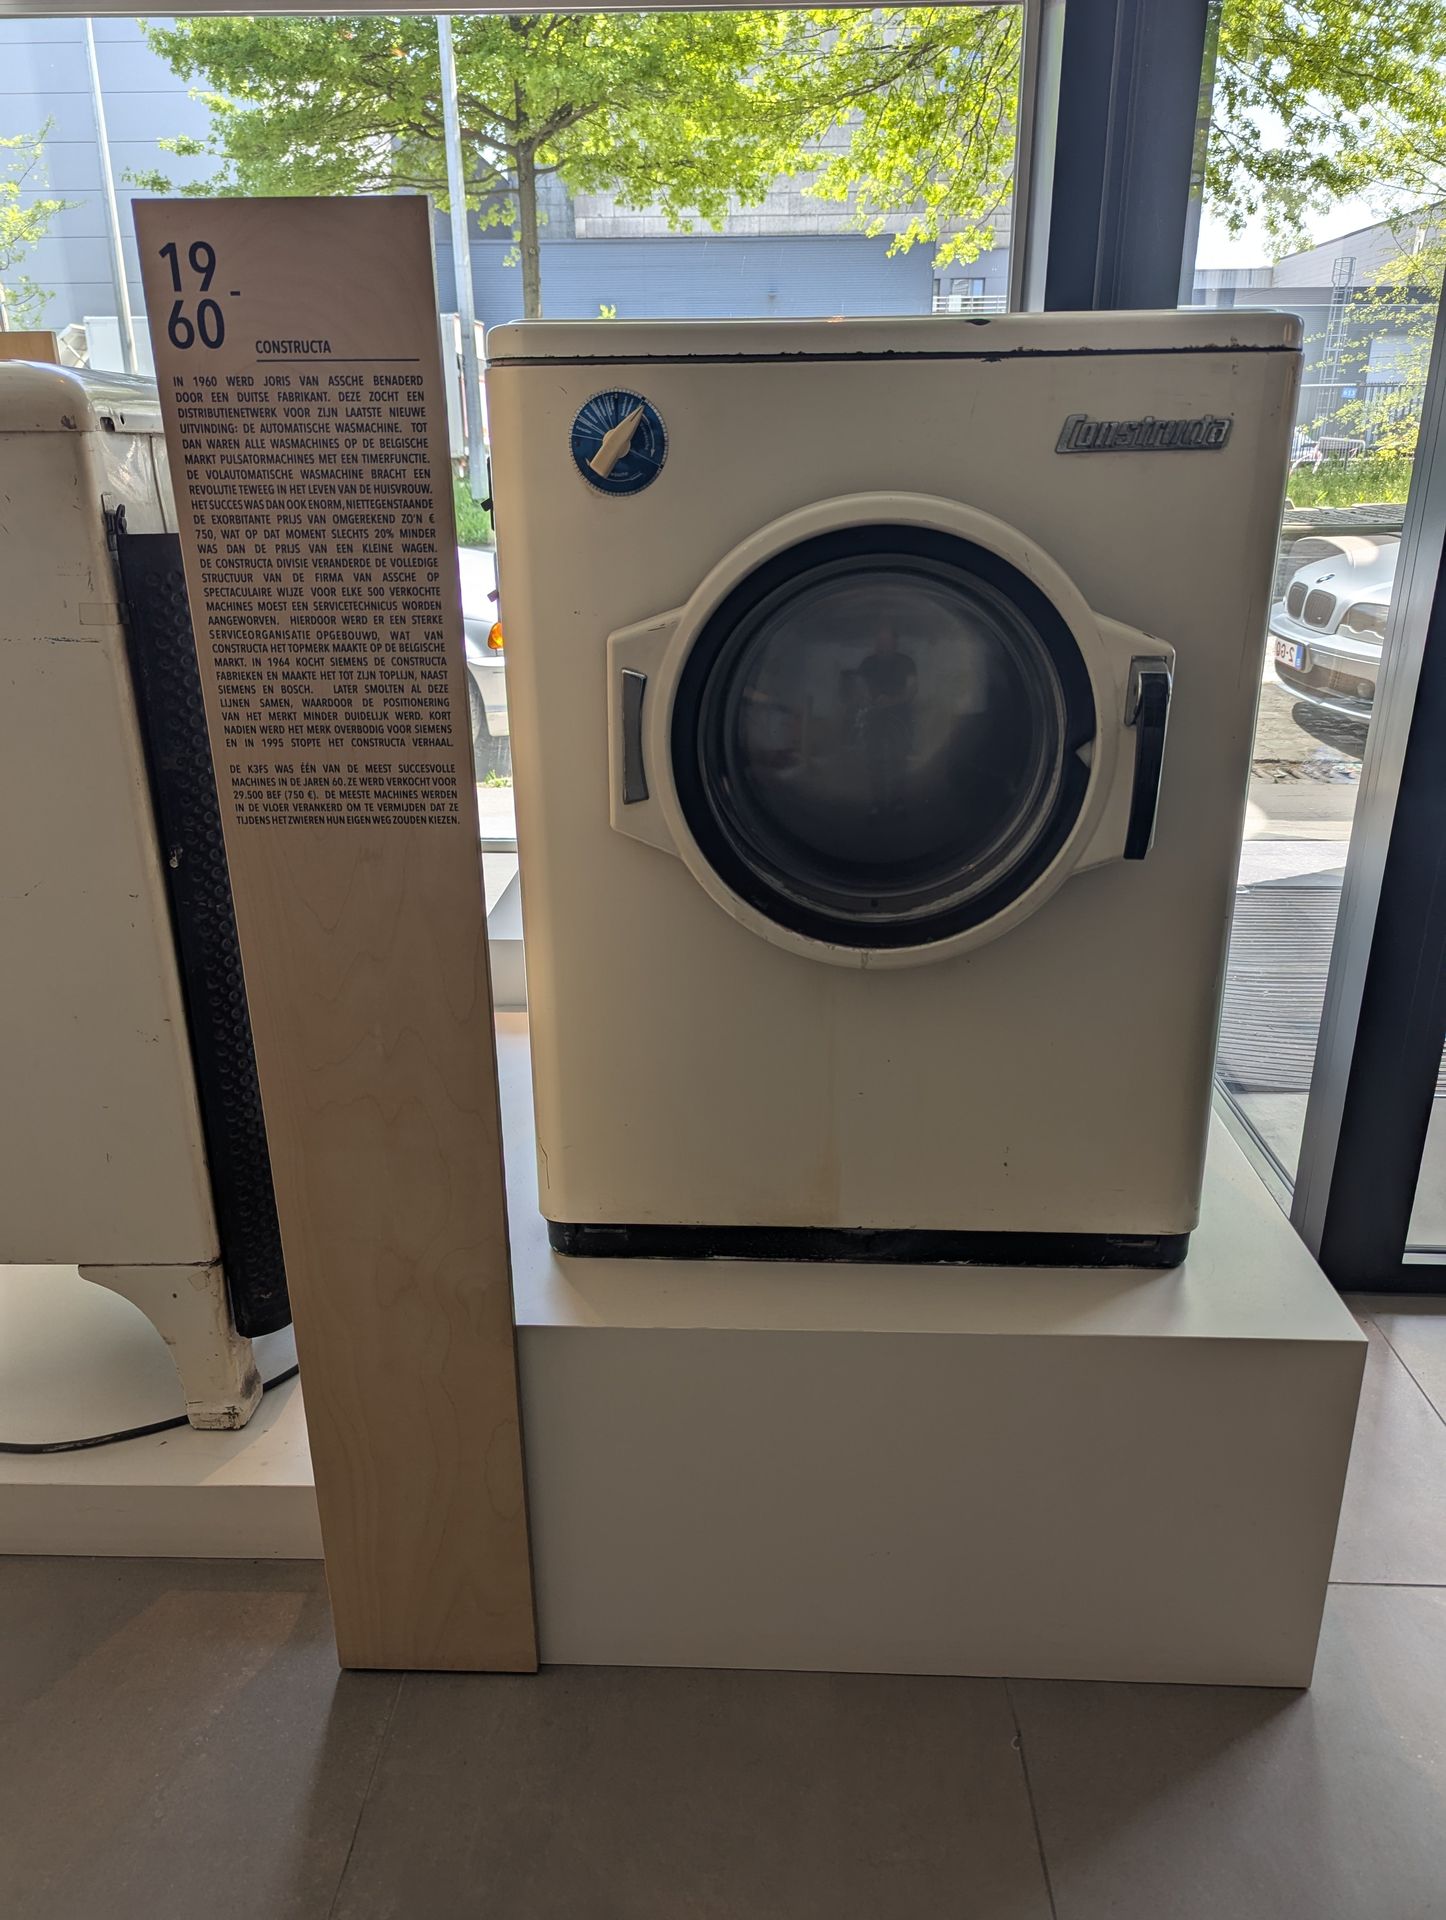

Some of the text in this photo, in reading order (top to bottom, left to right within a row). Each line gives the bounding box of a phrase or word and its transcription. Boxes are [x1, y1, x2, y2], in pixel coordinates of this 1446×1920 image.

[159, 241, 216, 292] 19
[168, 299, 224, 349] 60
[256, 340, 331, 353] CONSTRUCTA
[172, 375, 424, 386] IN 1960 WERD JORIS VAN ASSCHE BENADERD
[174, 391, 425, 402] DOOR EEN DUITSE FABRIKANT. DEZE ZOCHT EEN
[176, 407, 426, 417] DISTRIBUTIENETWERK VOOR ZIJN LAATSTE NIEUWE
[179, 422, 428, 433] UITVINDING: DE AUTOMATISCHE WASMACHINE. TOT
[1055, 414, 1231, 453] Constructa
[181, 438, 429, 448] DAN WAREN ALLE WASMACHINES OP DE BELGISCHE
[183, 453, 430, 464] MARKT PULSATORMACHINES MET EEN TIMERFUNCTIE.
[186, 468, 431, 479] DE VOLAUTOMATISCHE WASMACHINE BRACHT EEN
[192, 513, 435, 524] DE EXORBITANTE PRIJS VAN OMGEREKEND ZO'N €
[194, 528, 436, 539] 750, WAT OP DAT MOMENT SLECHTS 20% MINDER
[196, 543, 438, 553] WAS DAN DE PRIJS VAN EEN KLEINE WAGEN.
[199, 558, 438, 568] DE CONSTRUCTA DIVISIE VERANDERDE DE VOLLEDIGE
[200, 572, 440, 582] STRUCTUUR VAN DE FIRMA VAN ASSCHE OP
[202, 586, 441, 596] SPECTACULAIRE WIJZE VOOR ELKE 500 VERKOCHTE
[205, 601, 442, 611] MACHINES MOEST EEN SERVICETECHNICUS WORDEN
[206, 615, 443, 625] AANGEWORVEN. HIERDOOR WERD ER EEN STERKE
[208, 630, 443, 641] SERVICEORGANISATIE OPGEBOUWD, WAT VAN
[213, 656, 447, 666] MARKT. IN 1964 KOCHT SIEMENS DE CONSTRUCTA
[217, 684, 449, 694] SIEMENS EN BOSCH. LATER SMOLTEN AL DEZE
[219, 697, 450, 708] LIJNEN SAMEN, WAARDOOR DE POSITIONERING
[220, 711, 452, 720] VAN HET MERKT MINDER DUIDELIJK WERD. KORT
[225, 737, 454, 747] EN IN 1995 STOPTE HET CONSTRUCTA VERHAAL.
[229, 762, 455, 773] DE K3FS WAS ÉÉN VAN DE MEEST SUCCESVOLLE
[232, 789, 458, 800] 29.500 BEF (750 €). DE MEESTE MACHINES WERDEN
